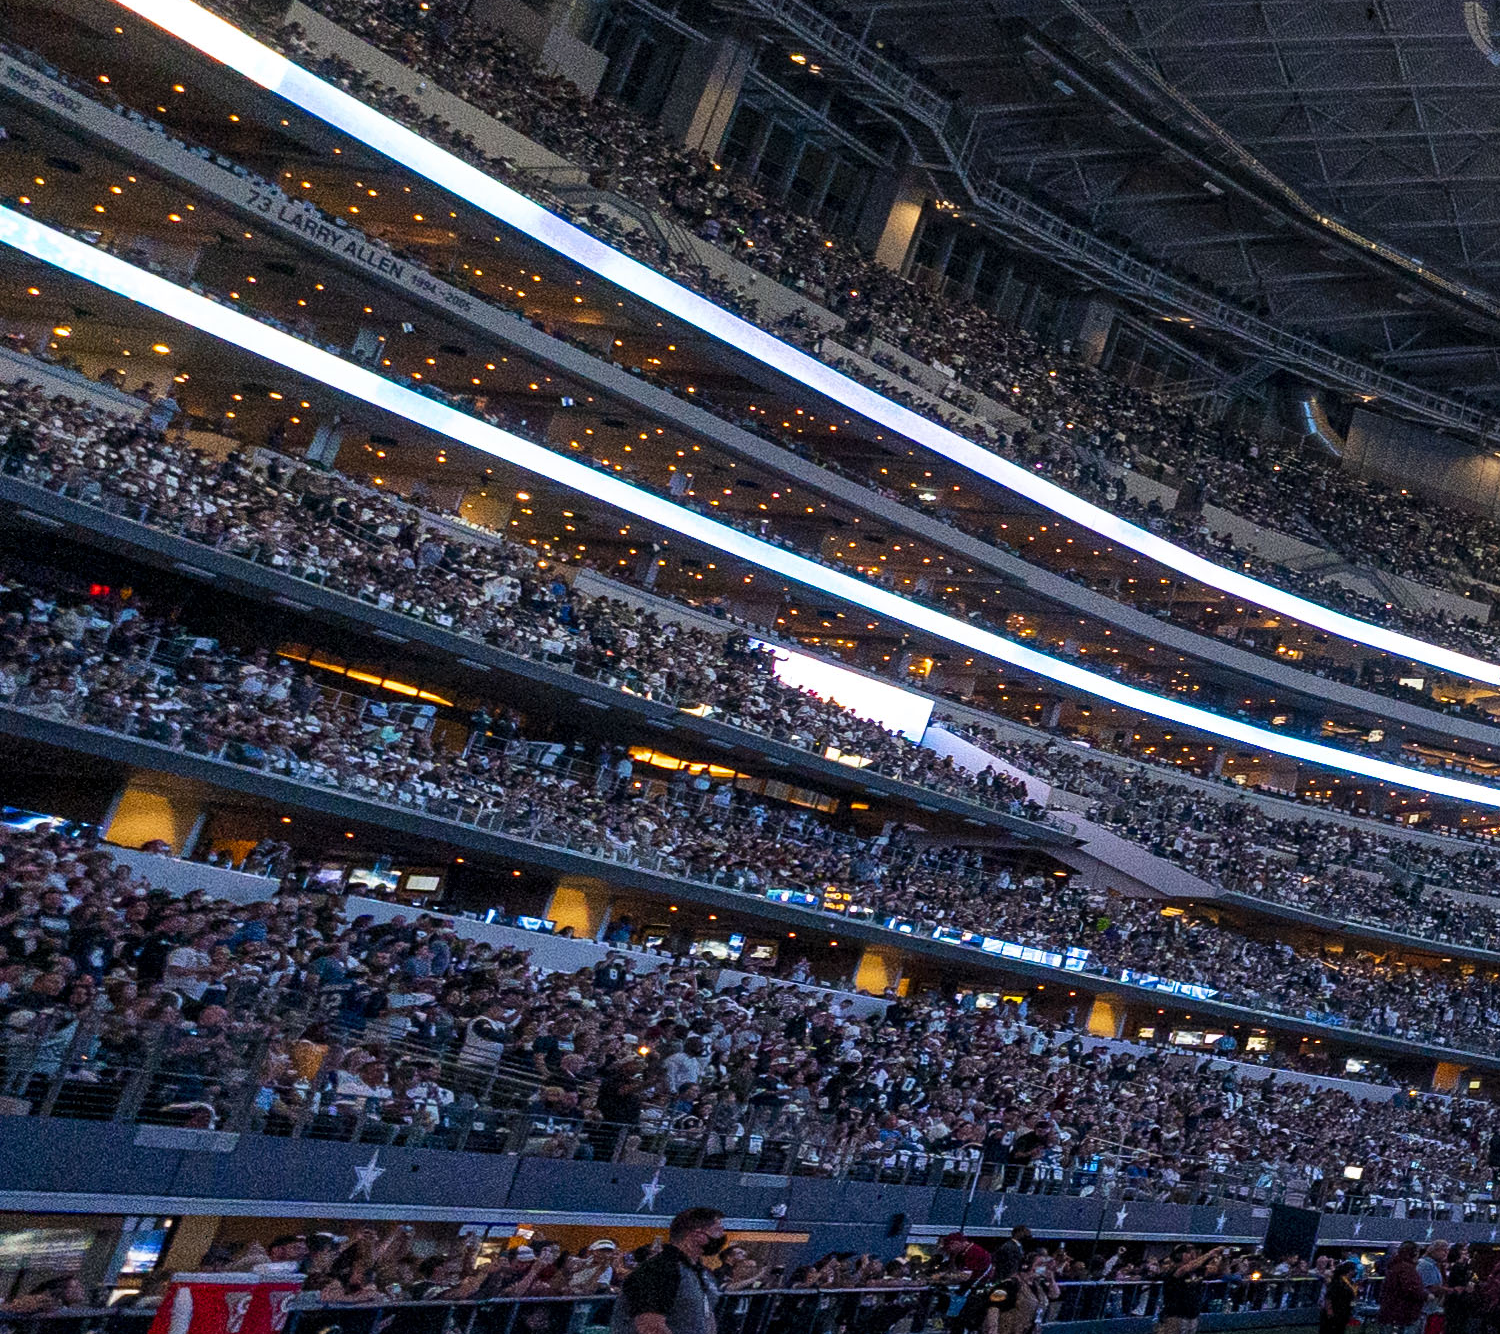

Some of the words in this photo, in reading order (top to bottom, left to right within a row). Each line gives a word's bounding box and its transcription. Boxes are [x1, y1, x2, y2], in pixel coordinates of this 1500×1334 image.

[248, 189, 273, 212] 73
[277, 205, 344, 247] LARRY
[342, 240, 404, 278] ALLEN
